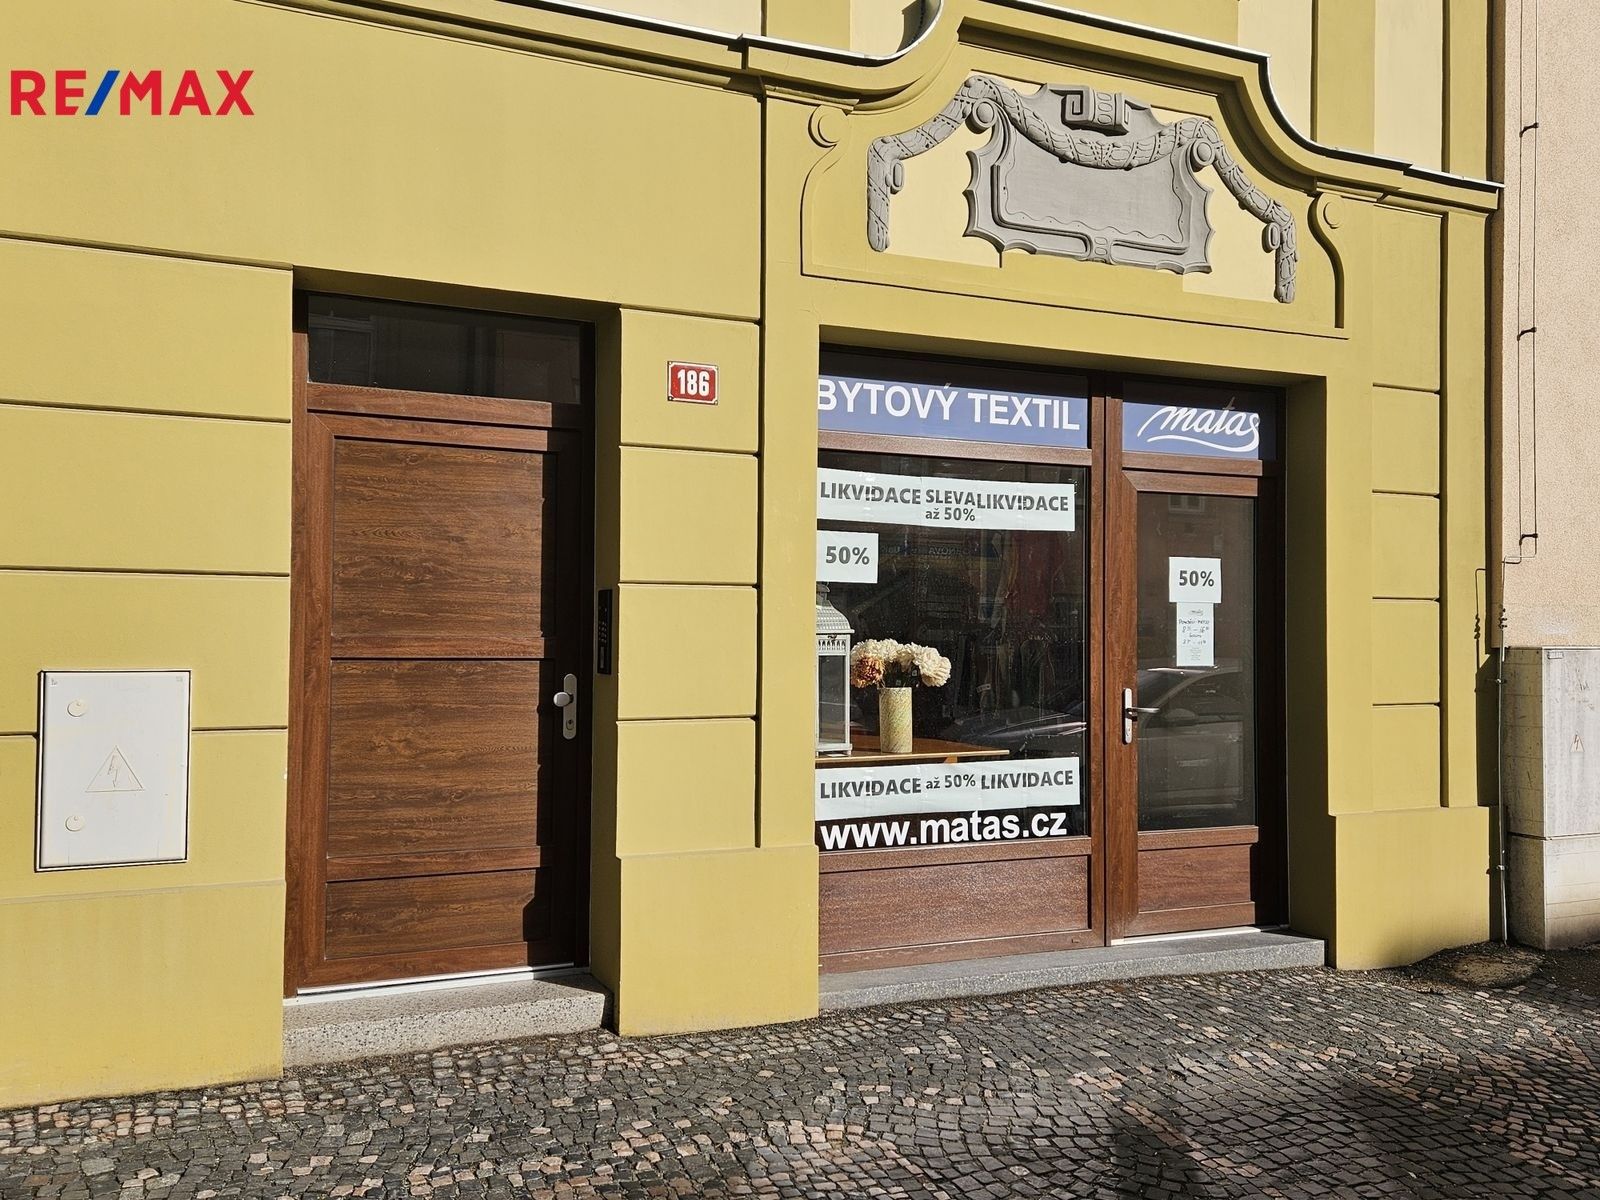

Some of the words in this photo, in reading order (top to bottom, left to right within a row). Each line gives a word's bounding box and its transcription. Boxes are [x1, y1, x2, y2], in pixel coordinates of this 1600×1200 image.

[677, 368, 710, 397] 186
[818, 379, 958, 420] BYTOVÝ
[968, 392, 1080, 430] TEXTIL
[925, 489, 976, 506] SLEVA
[925, 508, 940, 520] až
[944, 507, 976, 522] 50%
[825, 546, 870, 565] 50%
[1178, 570, 1215, 587] 50%
[926, 776, 941, 790] až
[944, 774, 976, 788] 50%
[980, 770, 1074, 790] LIKVIDACE
[820, 809, 1067, 850] www.matas.cz
